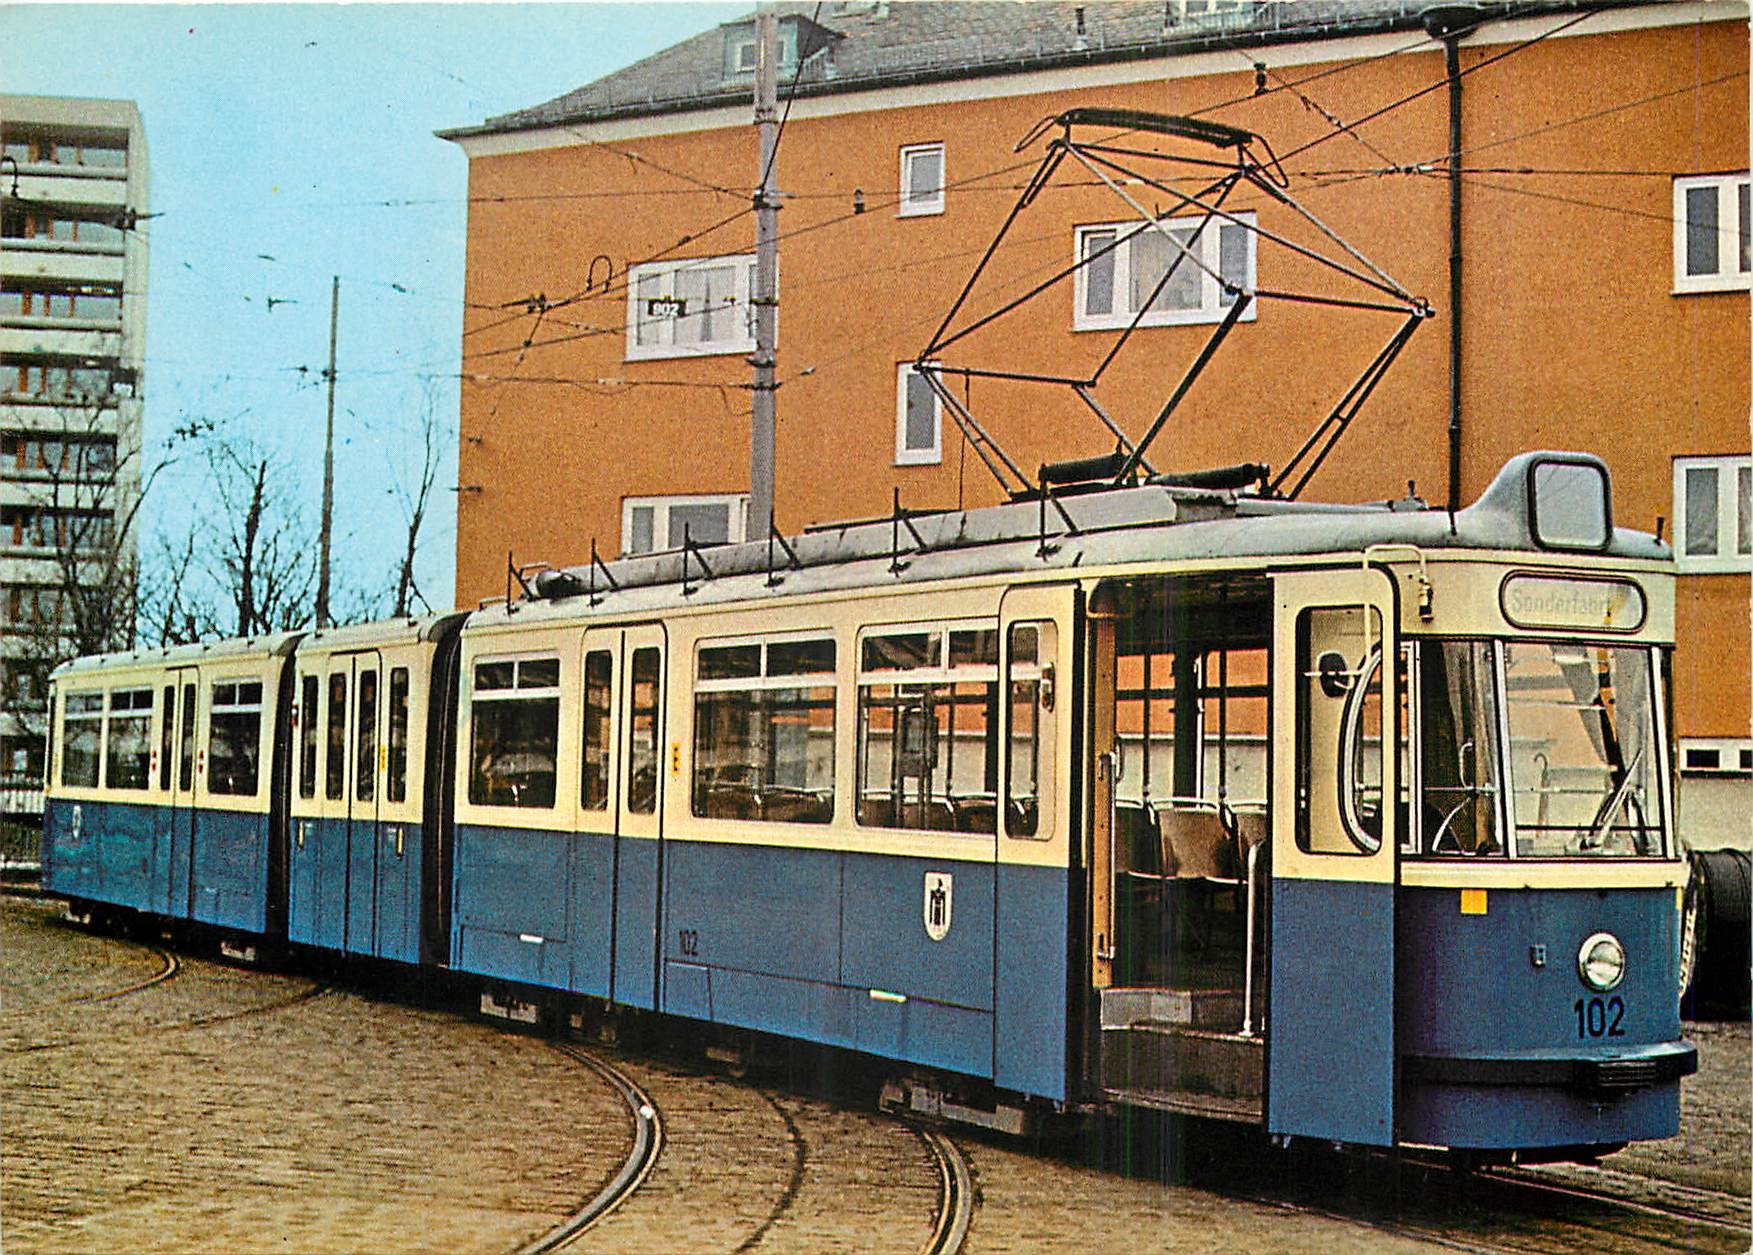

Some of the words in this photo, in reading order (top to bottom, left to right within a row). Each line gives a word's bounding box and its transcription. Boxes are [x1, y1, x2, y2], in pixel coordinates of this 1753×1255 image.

[1512, 588, 1612, 615] Sonderfahr
[679, 929, 699, 956] 102
[1574, 996, 1626, 1039] 102
